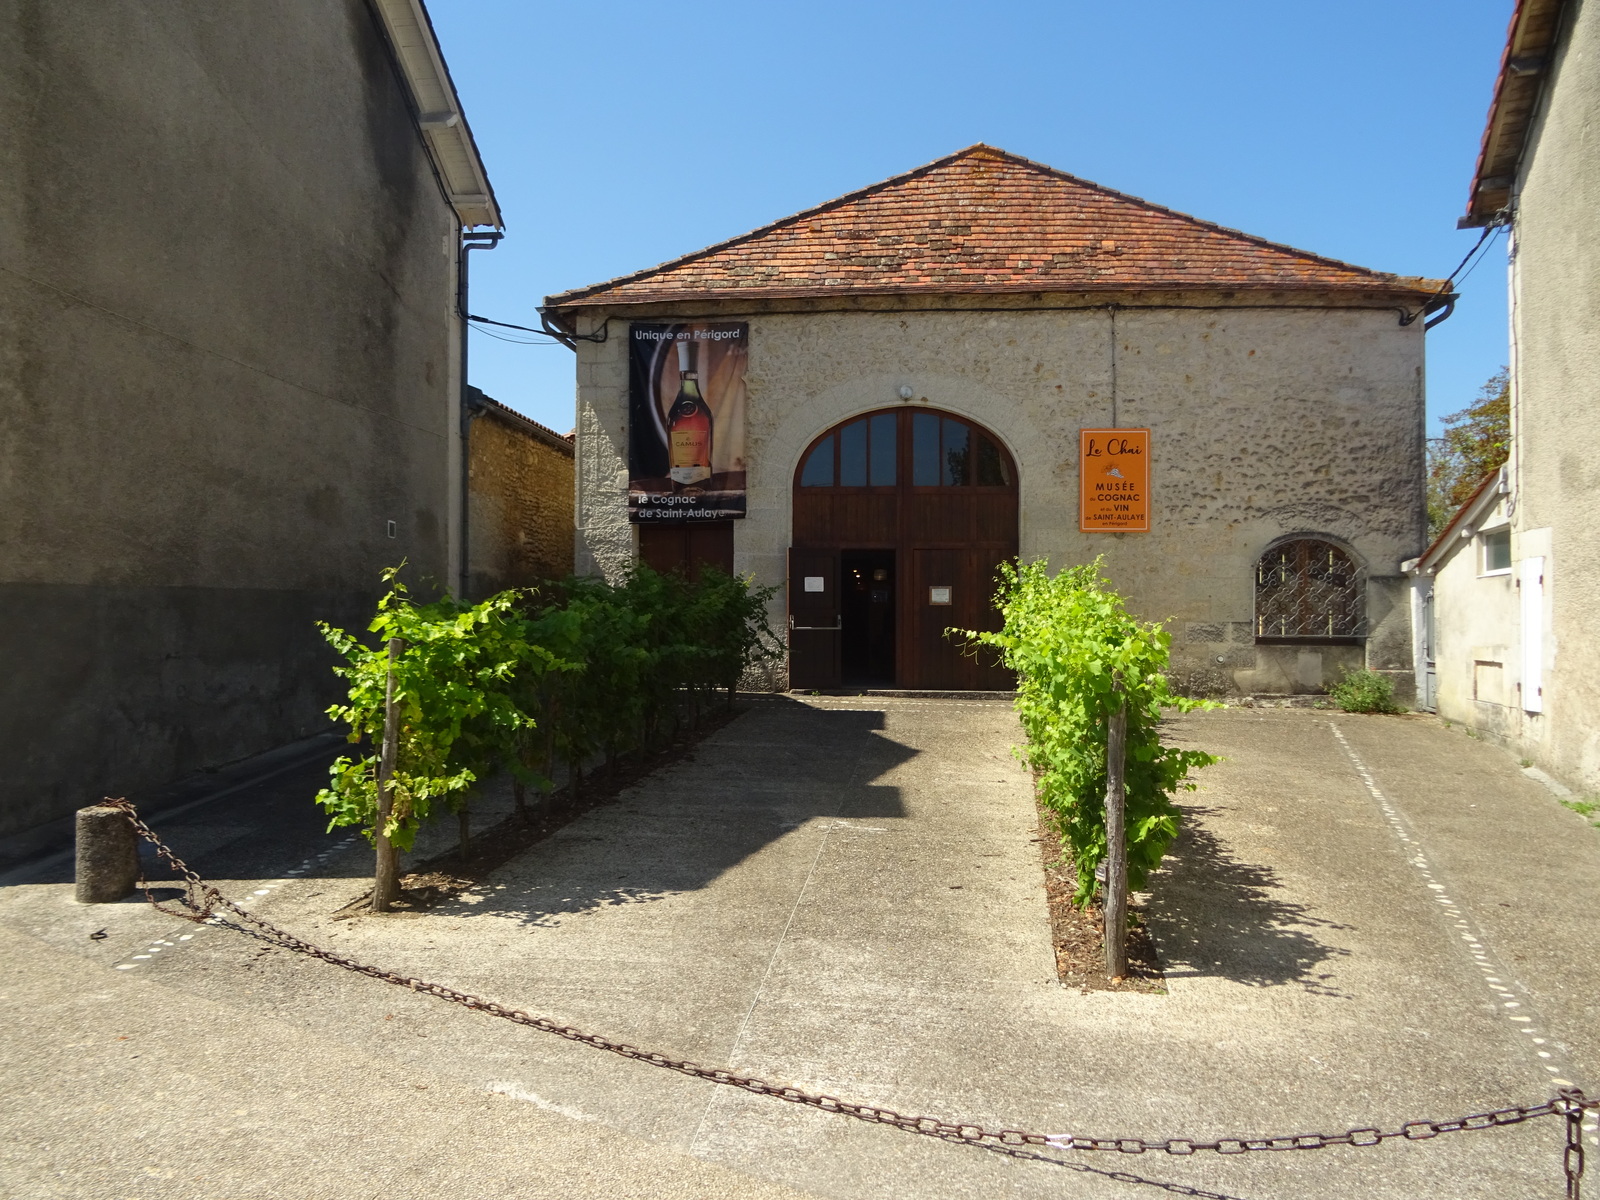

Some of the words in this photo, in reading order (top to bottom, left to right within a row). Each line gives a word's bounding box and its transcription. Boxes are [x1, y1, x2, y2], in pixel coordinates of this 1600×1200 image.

[635, 330, 673, 341] Unique
[676, 332, 691, 340] en
[694, 328, 740, 341] Périgord
[1086, 438, 1102, 457] Le
[1107, 438, 1142, 456] Chai
[1095, 480, 1135, 491] MUSÉE
[638, 494, 648, 504] le
[651, 496, 696, 506] Cognac
[1097, 493, 1140, 502] COGNAC
[639, 509, 653, 518] de
[655, 508, 725, 519] Saint-Aulaye
[1113, 504, 1129, 512] VIN
[1093, 513, 1145, 521] SAINT-AULAYE
